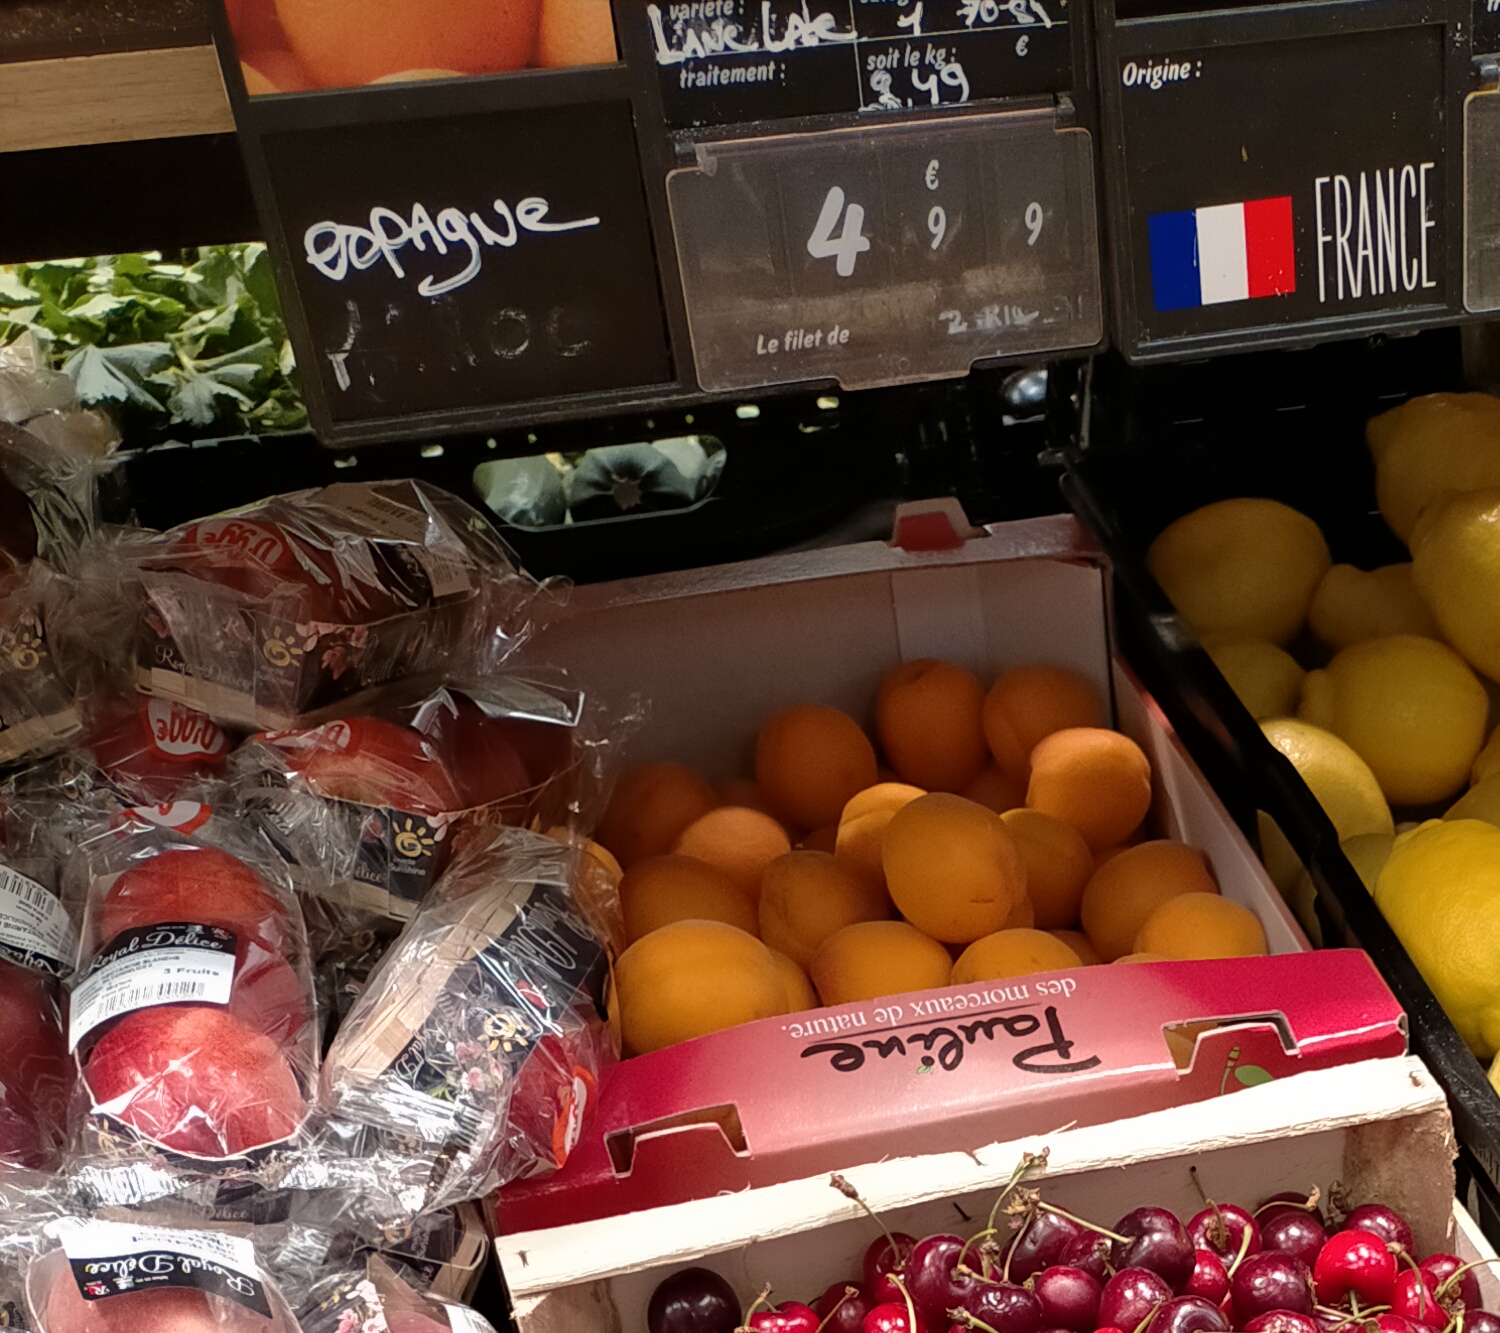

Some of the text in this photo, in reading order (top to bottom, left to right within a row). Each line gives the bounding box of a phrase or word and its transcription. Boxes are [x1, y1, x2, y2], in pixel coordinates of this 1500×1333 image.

[680, 63, 776, 89] traitement
[867, 46, 947, 72] soit le kg
[1122, 58, 1191, 89] Origine
[806, 185, 870, 277] 4
[928, 206, 946, 250] 9
[1024, 202, 1043, 246] 9
[1314, 162, 1437, 303] FRANCE
[757, 326, 850, 355] Le filet de
[781, 977, 1077, 1040] des morceaux de nature.
[800, 1006, 1102, 1074] Pauline
